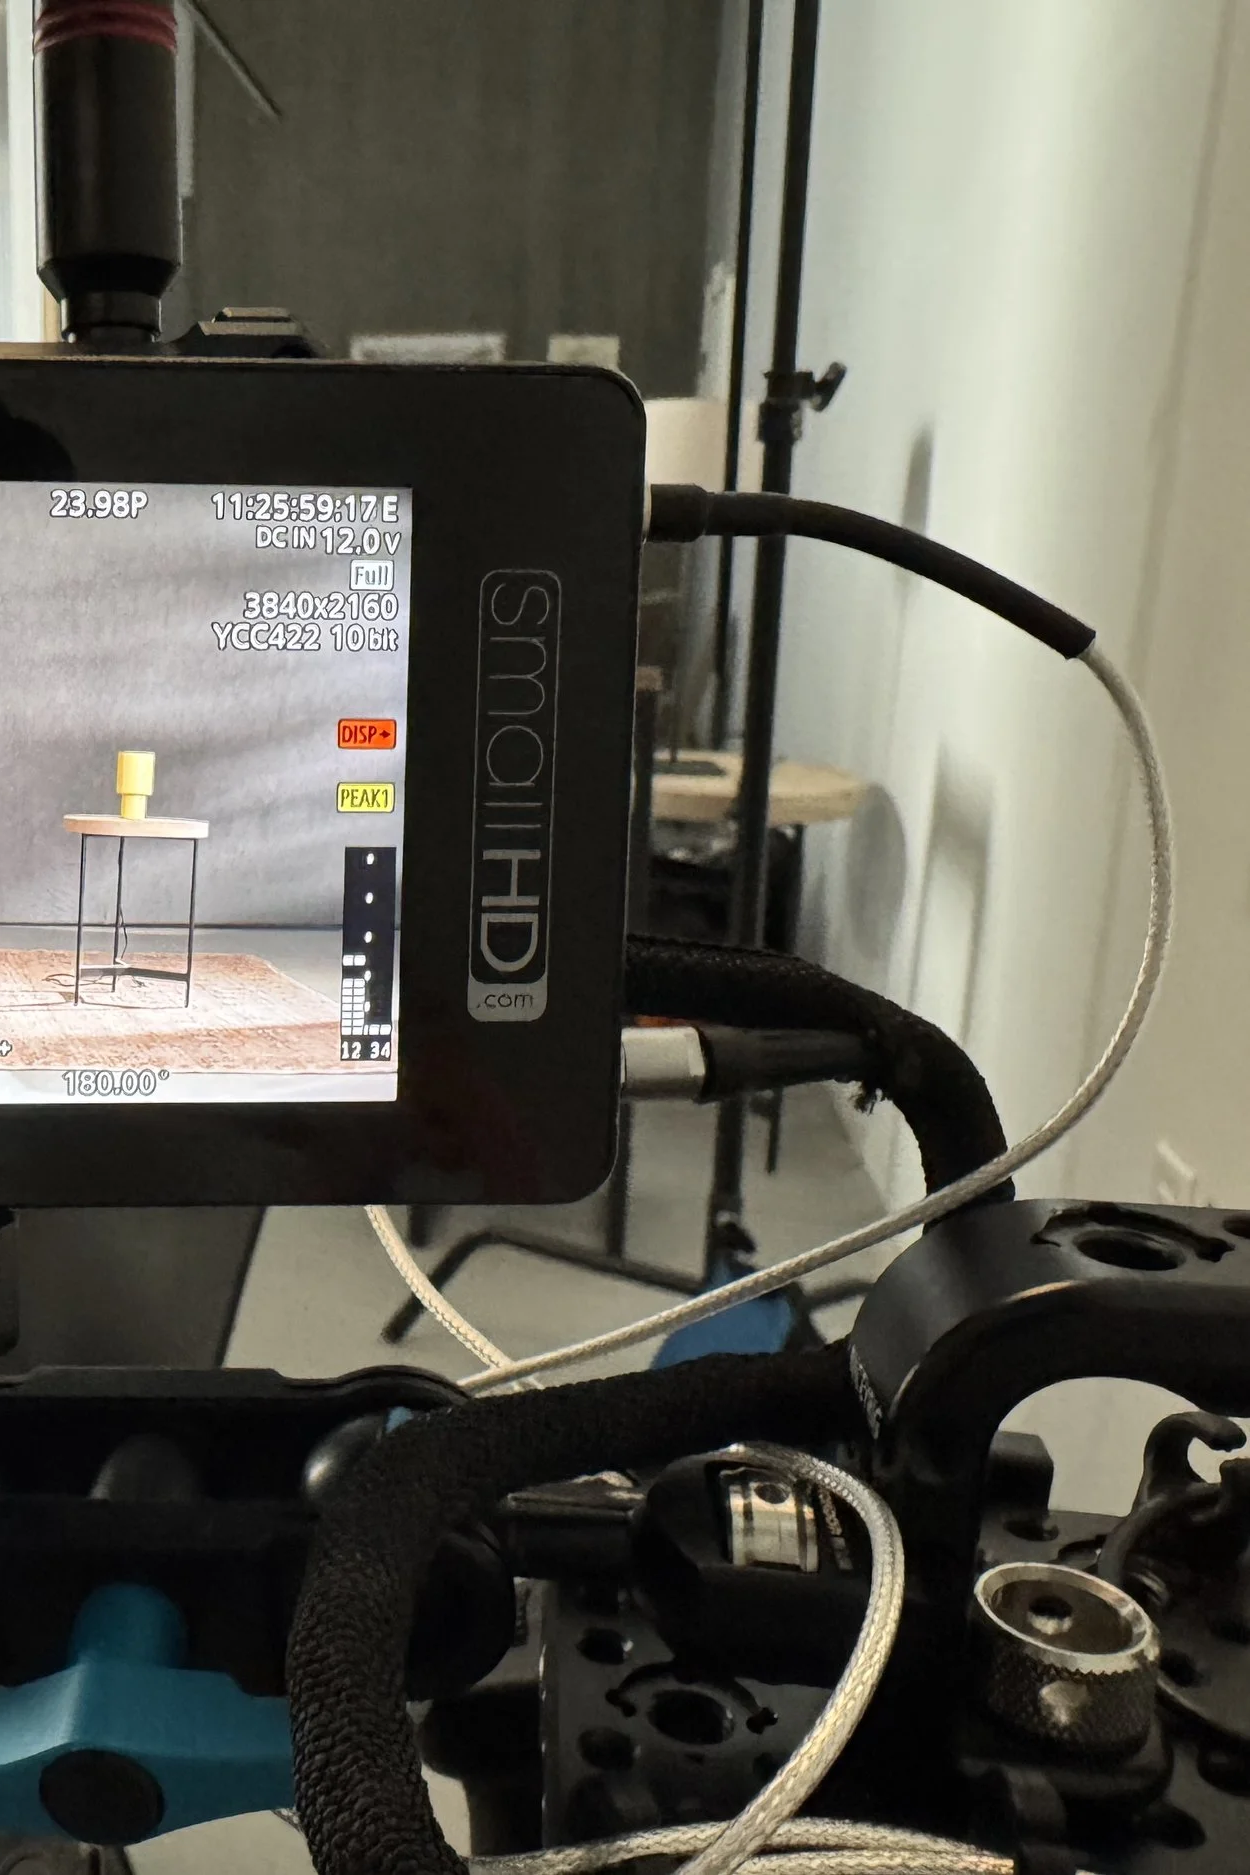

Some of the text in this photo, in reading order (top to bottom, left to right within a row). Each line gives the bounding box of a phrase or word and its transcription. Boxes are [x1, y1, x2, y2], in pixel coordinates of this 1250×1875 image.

[50, 489, 148, 518] 23.98P
[255, 525, 288, 549] DC
[292, 526, 316, 549] IN
[354, 565, 389, 586] Full
[243, 591, 398, 621] 3840x2160
[211, 622, 321, 651] YCC422
[340, 788, 389, 808] PEAK1
[476, 993, 534, 1009] .com
